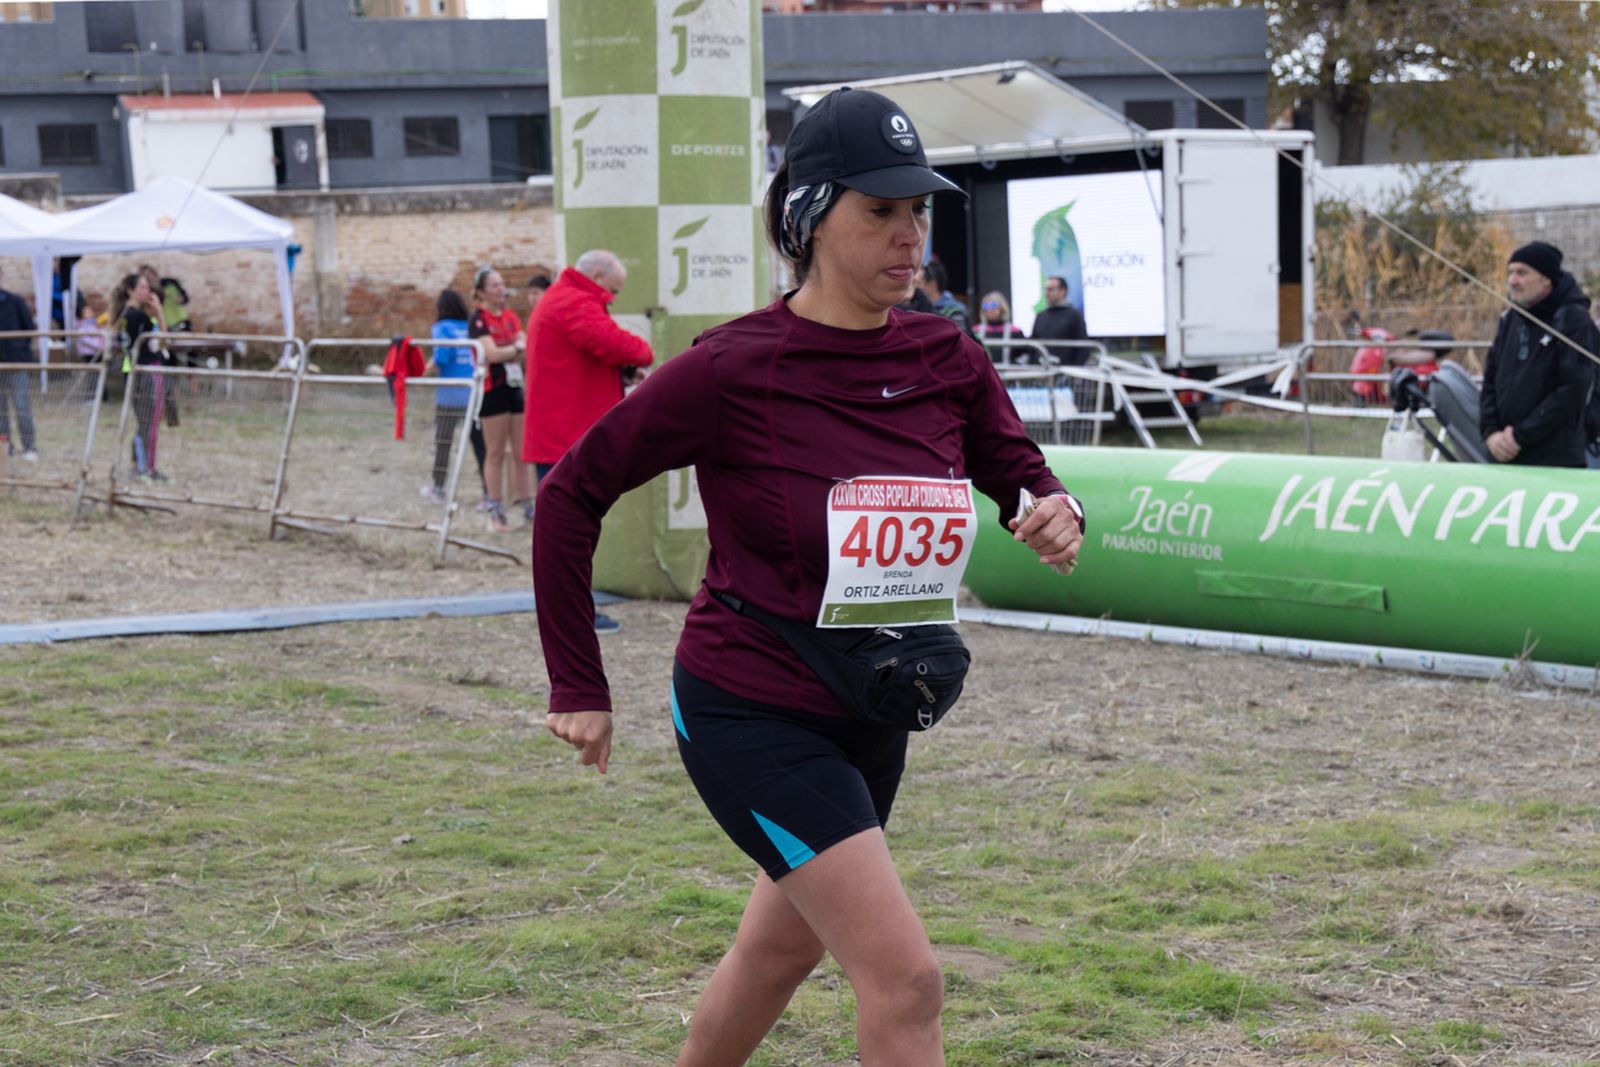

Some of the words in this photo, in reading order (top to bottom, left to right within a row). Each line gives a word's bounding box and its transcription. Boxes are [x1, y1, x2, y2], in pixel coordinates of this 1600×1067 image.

[690, 47, 705, 58] DE
[585, 144, 648, 157] DIPUTACIÓN
[671, 144, 745, 157] DEPORTES
[585, 160, 598, 171] DE
[691, 268, 705, 279] DE
[857, 484, 885, 507] CROSS
[886, 484, 920, 508] POPULAR
[1119, 485, 1214, 539] Jaén
[1259, 468, 1435, 543] JAÉN
[840, 516, 967, 568] 4035
[1102, 532, 1158, 555] PARAÍSO
[1159, 540, 1223, 562] INTERIOR
[883, 570, 913, 579] BRENDA
[844, 585, 881, 598] ORTIZ
[881, 582, 944, 597] ARELLANO
